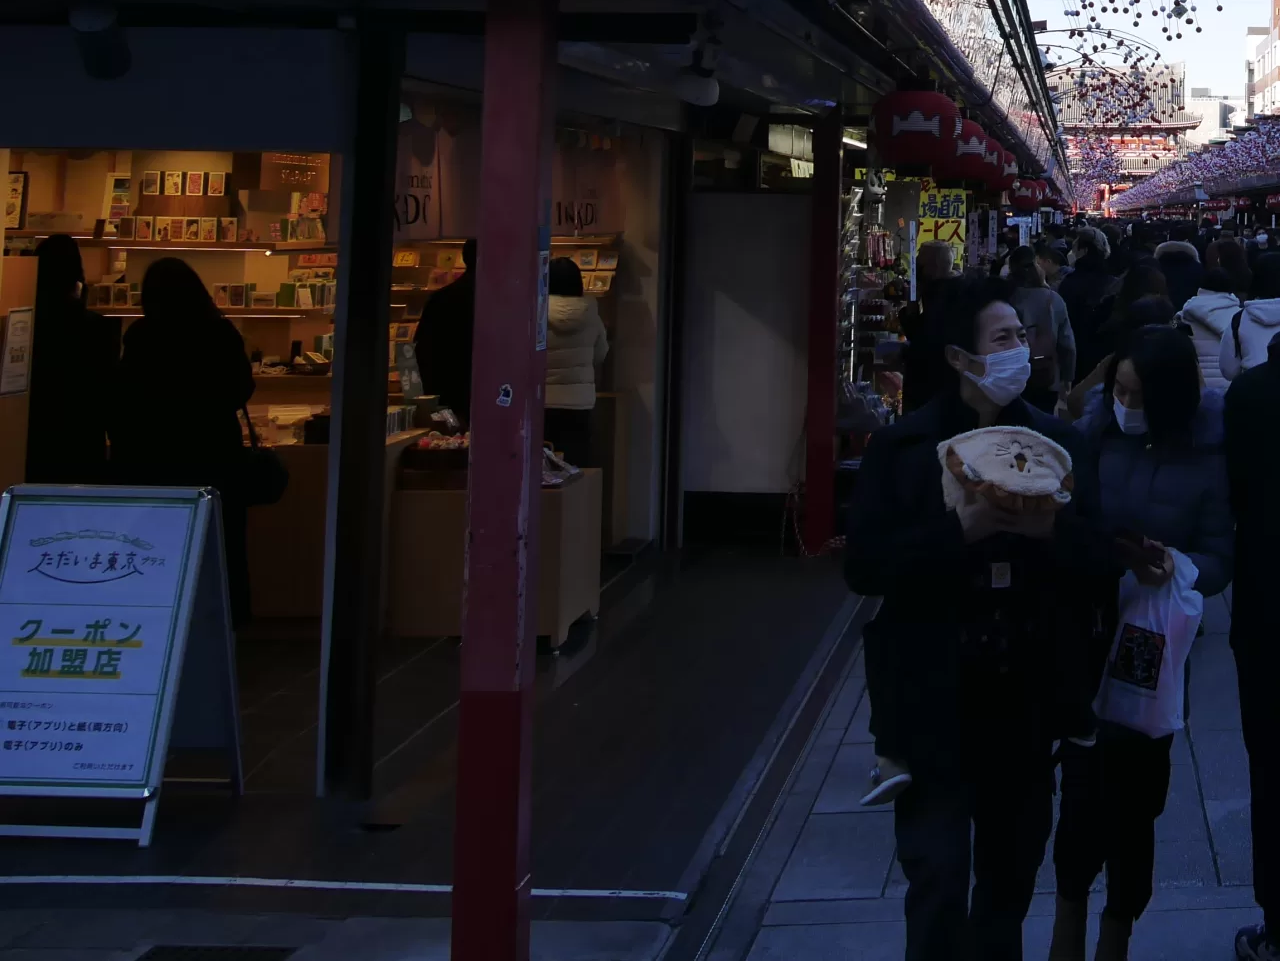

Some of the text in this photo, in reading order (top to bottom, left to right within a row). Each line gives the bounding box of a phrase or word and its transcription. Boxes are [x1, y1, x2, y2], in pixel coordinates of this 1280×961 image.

[28, 551, 144, 574] ただいま東京
[19, 618, 142, 644] クーポン
[26, 647, 122, 675] 加盟店
